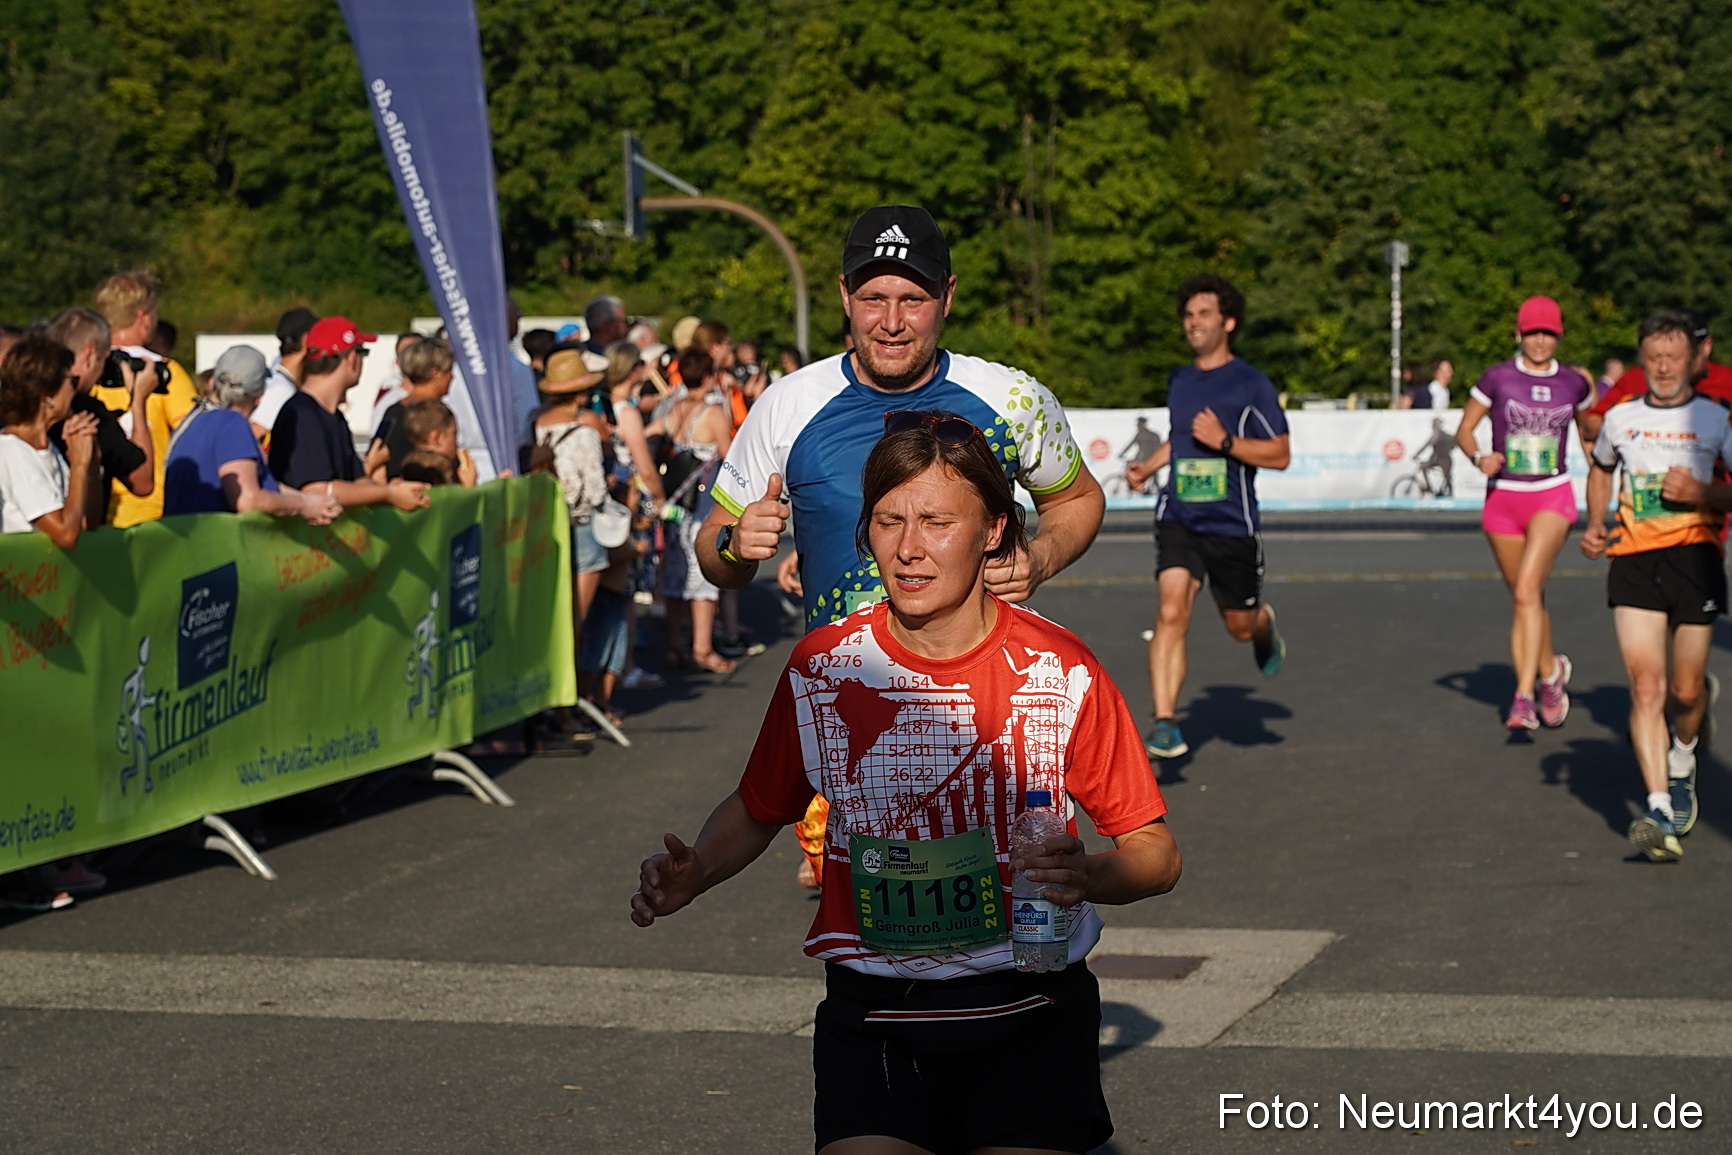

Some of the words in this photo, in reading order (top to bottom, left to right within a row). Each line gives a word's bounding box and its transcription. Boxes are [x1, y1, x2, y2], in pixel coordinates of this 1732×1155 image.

[875, 235, 910, 245] adidas
[888, 676, 930, 689] 10.54
[888, 768, 934, 782] 26.22
[883, 861, 929, 871] Firmenlauf
[900, 868, 929, 876] neumarkt
[874, 875, 977, 917] 1118
[980, 875, 998, 929] 2022
[860, 888, 873, 928] RUN
[876, 919, 941, 936] Gerngroß
[946, 916, 981, 932] Julia
